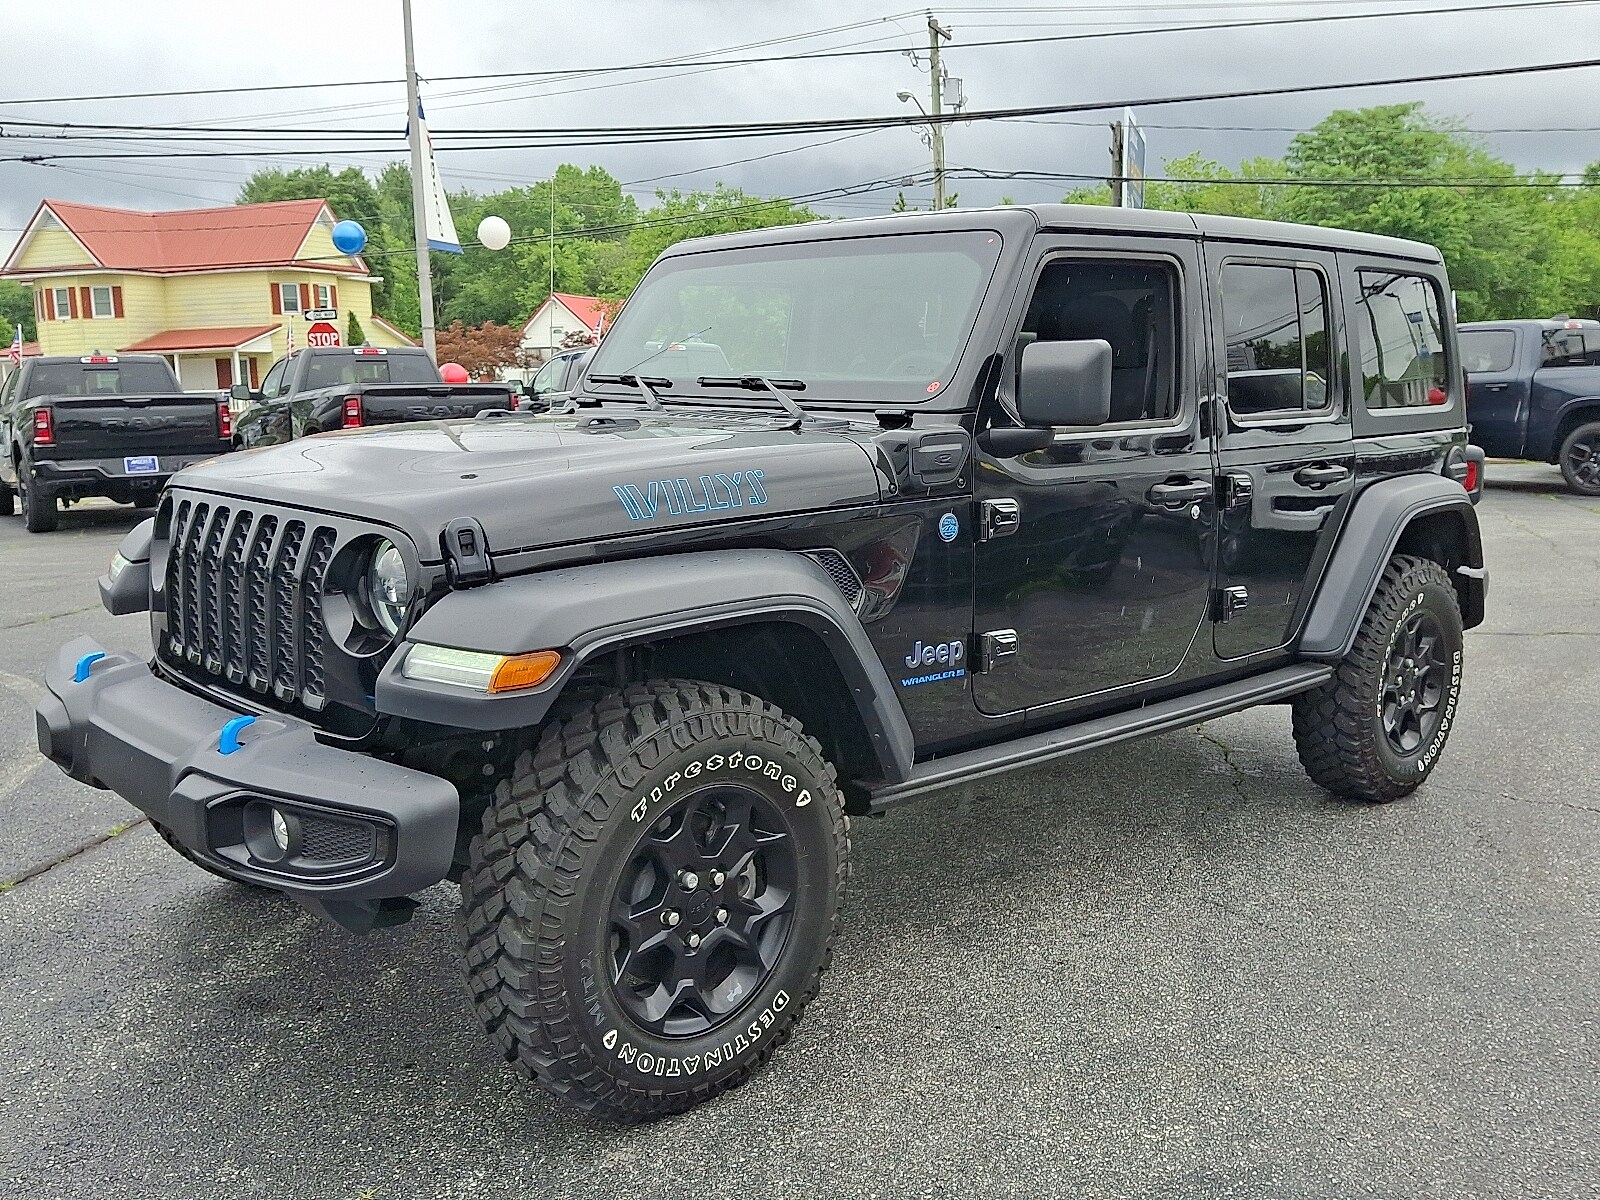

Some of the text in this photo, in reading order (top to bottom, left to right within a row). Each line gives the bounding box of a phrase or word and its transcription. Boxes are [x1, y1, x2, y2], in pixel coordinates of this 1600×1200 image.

[308, 332, 338, 347] STOP
[100, 415, 177, 428] RAM
[406, 405, 474, 416] RAM
[612, 469, 768, 520] WILLYS
[905, 640, 964, 669] Jeep
[901, 670, 956, 687] WRANGLER
[1423, 651, 1461, 766] DESTINATION
[630, 750, 798, 823] Firestone
[618, 989, 790, 1077] DESTINATION
